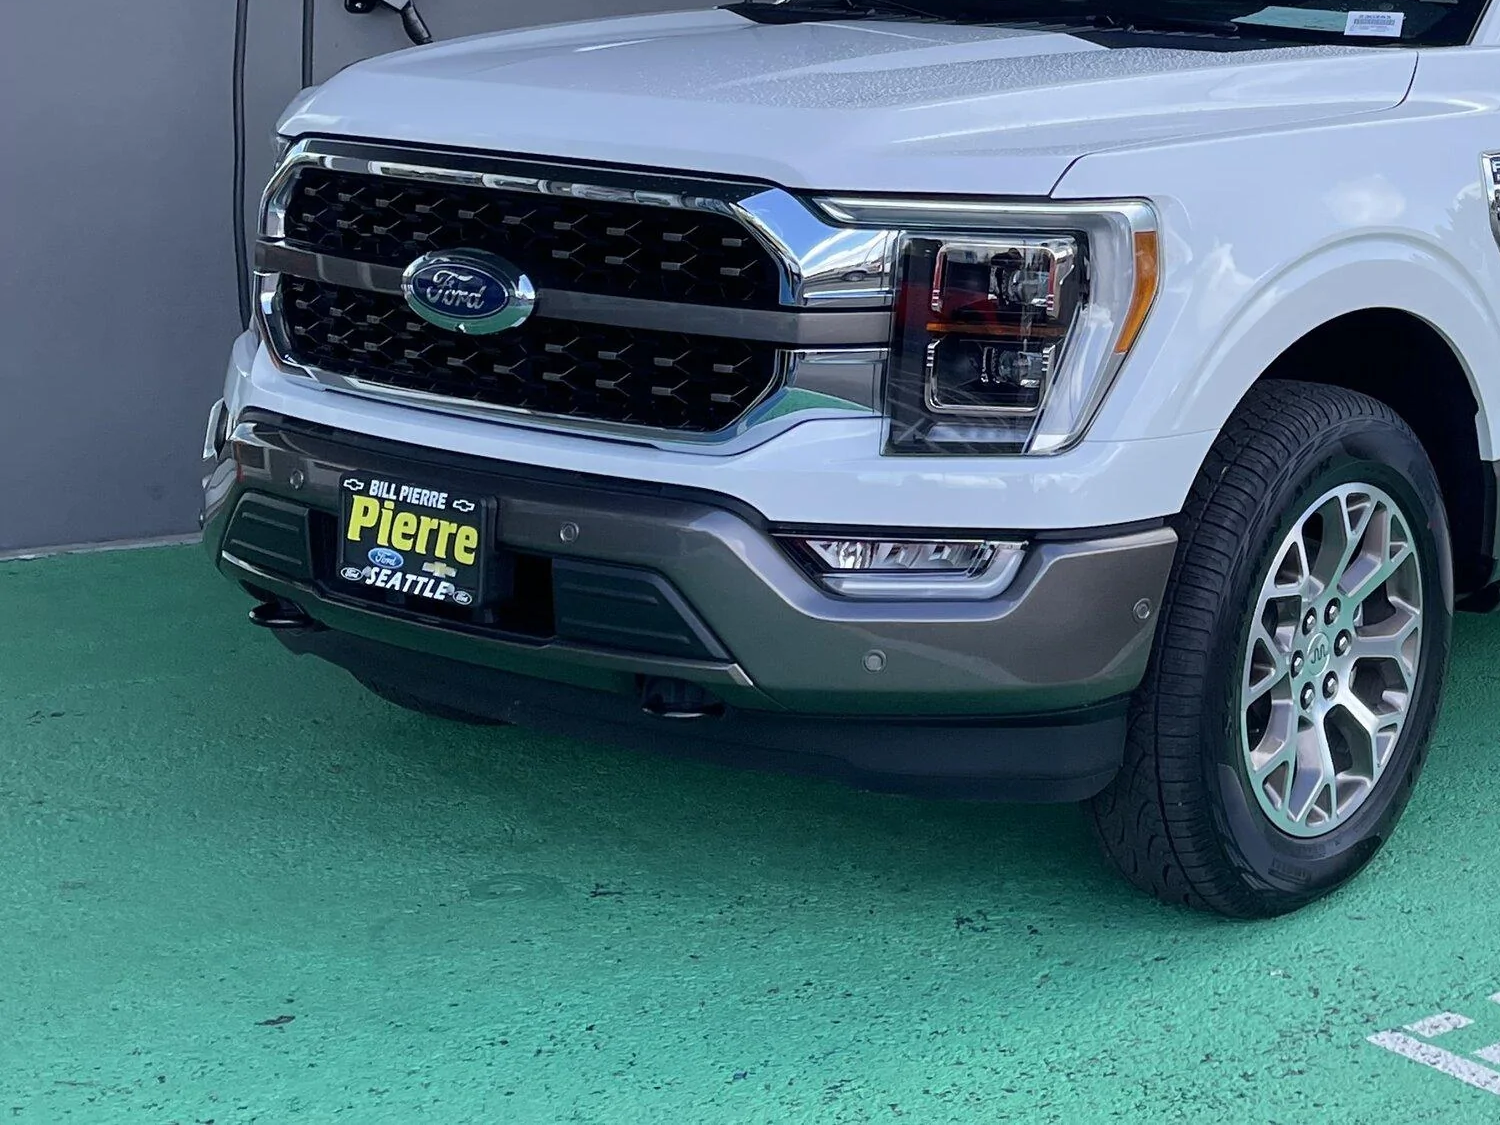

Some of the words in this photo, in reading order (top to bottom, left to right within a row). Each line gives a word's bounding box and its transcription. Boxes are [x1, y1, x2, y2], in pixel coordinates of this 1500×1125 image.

[425, 270, 487, 310] Ford
[369, 479, 397, 500] BILL
[399, 485, 448, 509] PIERRE
[347, 495, 478, 565] Pierre
[374, 551, 398, 567] Ford
[365, 566, 451, 601] SEATTLE
